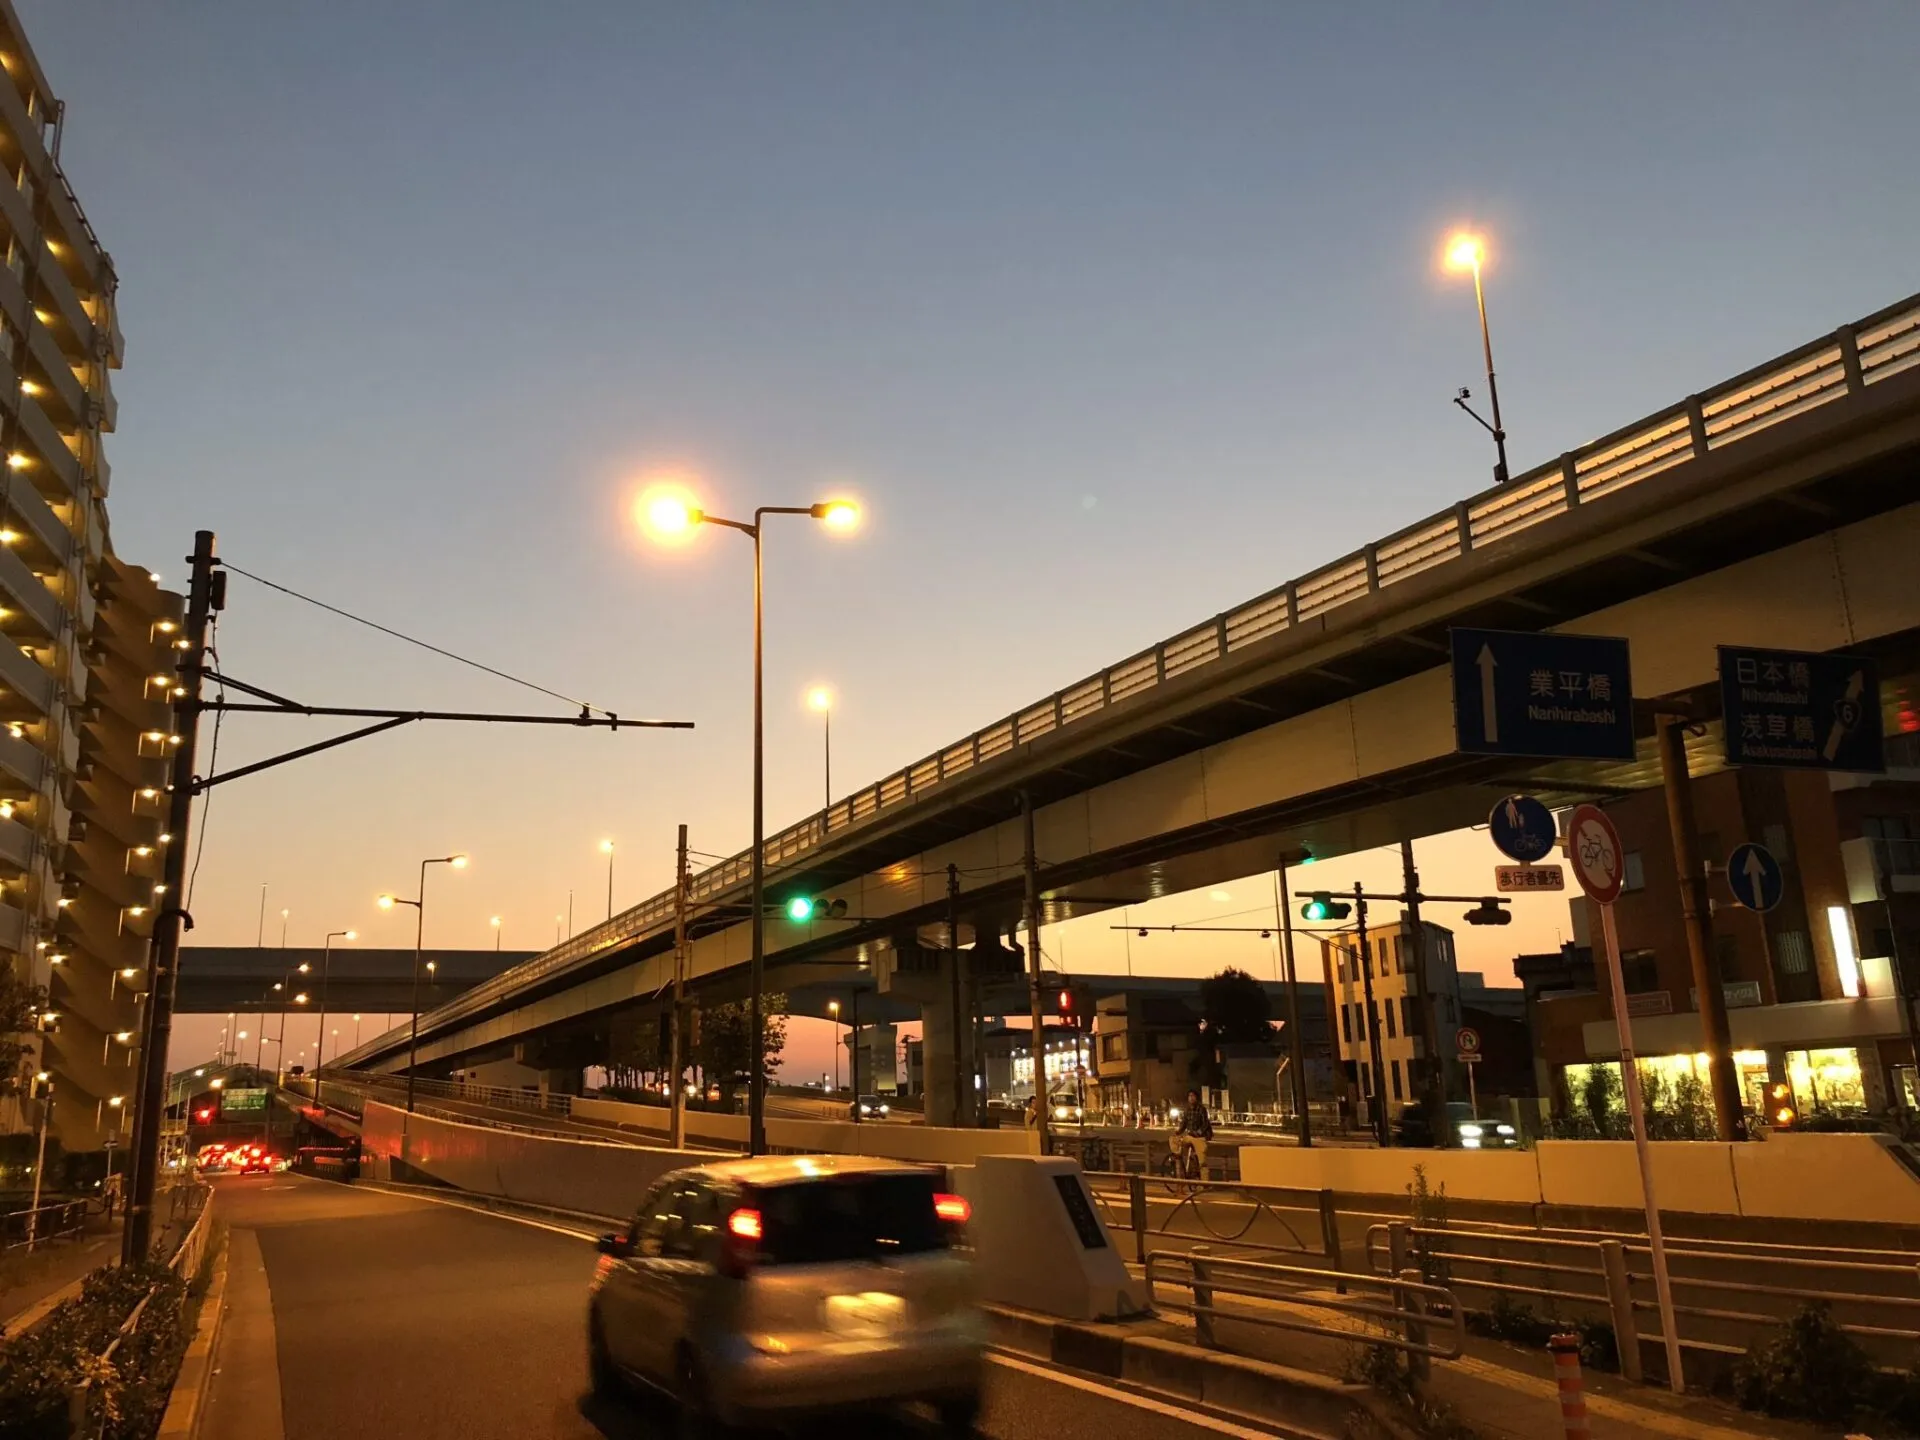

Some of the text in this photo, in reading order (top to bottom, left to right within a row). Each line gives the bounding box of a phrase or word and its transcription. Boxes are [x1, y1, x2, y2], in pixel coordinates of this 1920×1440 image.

[1736, 657, 1811, 689] 日本橋
[1529, 668, 1612, 702] 業平橋
[1741, 687, 1809, 705] Nihonbashi
[1527, 704, 1616, 725] Narihirabashi
[1842, 704, 1854, 725] 6
[1740, 712, 1815, 743] 浅草橋
[1499, 868, 1561, 886] 歩行者優先
